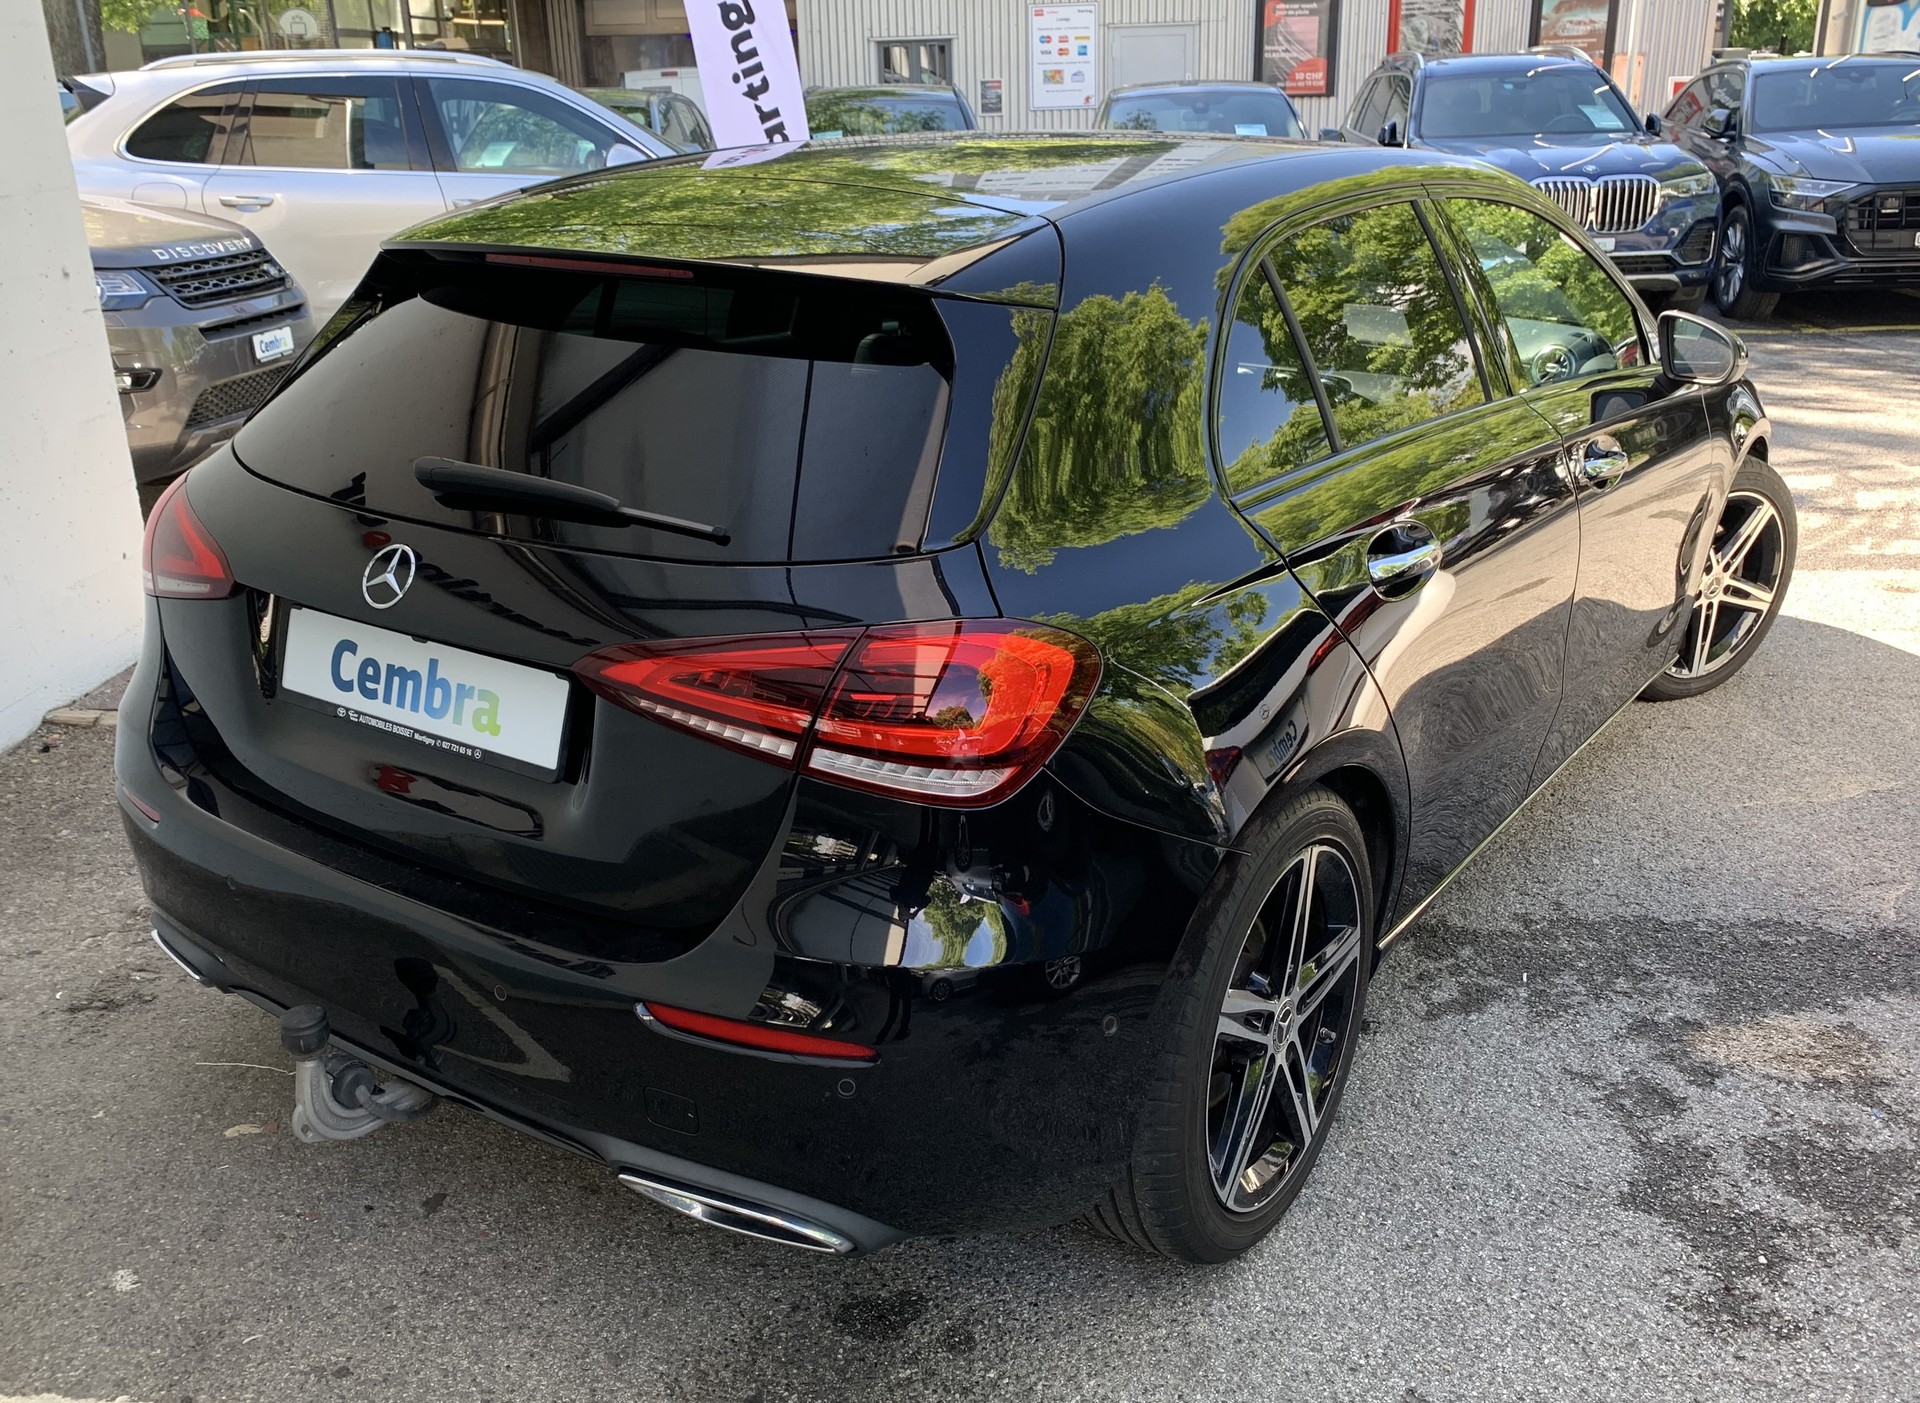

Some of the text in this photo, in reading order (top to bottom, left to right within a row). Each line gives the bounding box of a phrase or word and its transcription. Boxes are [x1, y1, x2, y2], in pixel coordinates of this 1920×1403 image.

[1295, 72, 1323, 80] 10 CHF
[152, 237, 252, 260] DISCOVERY
[260, 335, 288, 354] Cembra
[330, 638, 502, 737] Cembra
[359, 714, 392, 731] AUTOMOBILES
[392, 724, 414, 738] BOISSET
[414, 732, 435, 746] Martigny
[441, 741, 450, 749] 027
[450, 743, 459, 752] 721
[459, 746, 466, 754] 65
[466, 748, 472, 756] 16
